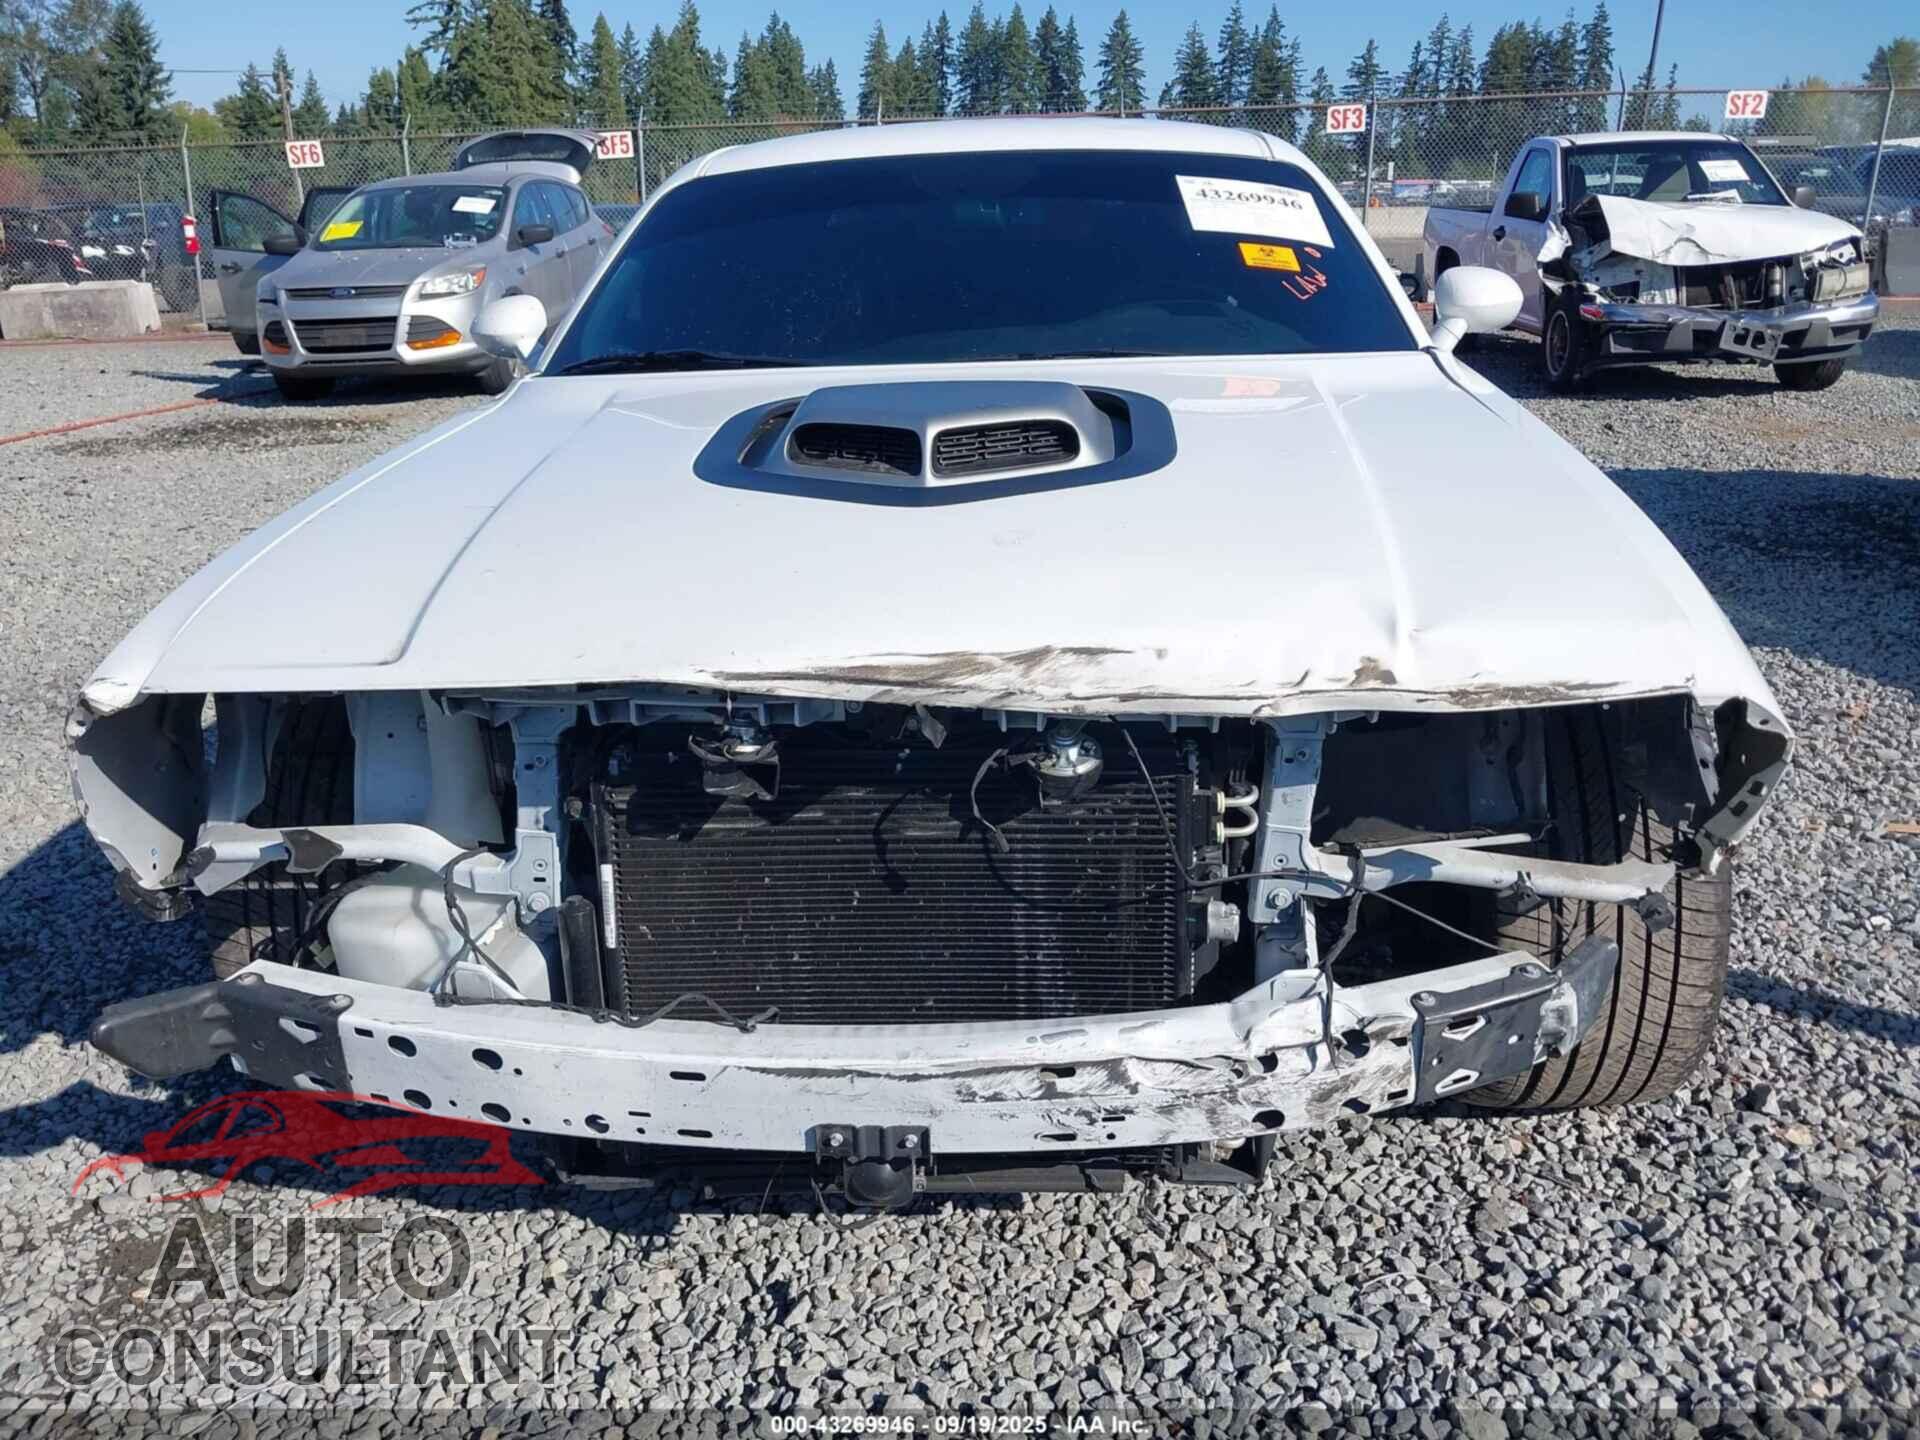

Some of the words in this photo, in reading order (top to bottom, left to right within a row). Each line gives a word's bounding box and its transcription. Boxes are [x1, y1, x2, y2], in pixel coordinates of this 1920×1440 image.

[1728, 94, 1764, 116] SF2
[1330, 107, 1364, 130] SF3
[288, 143, 321, 165] SF6
[600, 133, 630, 156] SF5
[1195, 188, 1304, 211] 43269946
